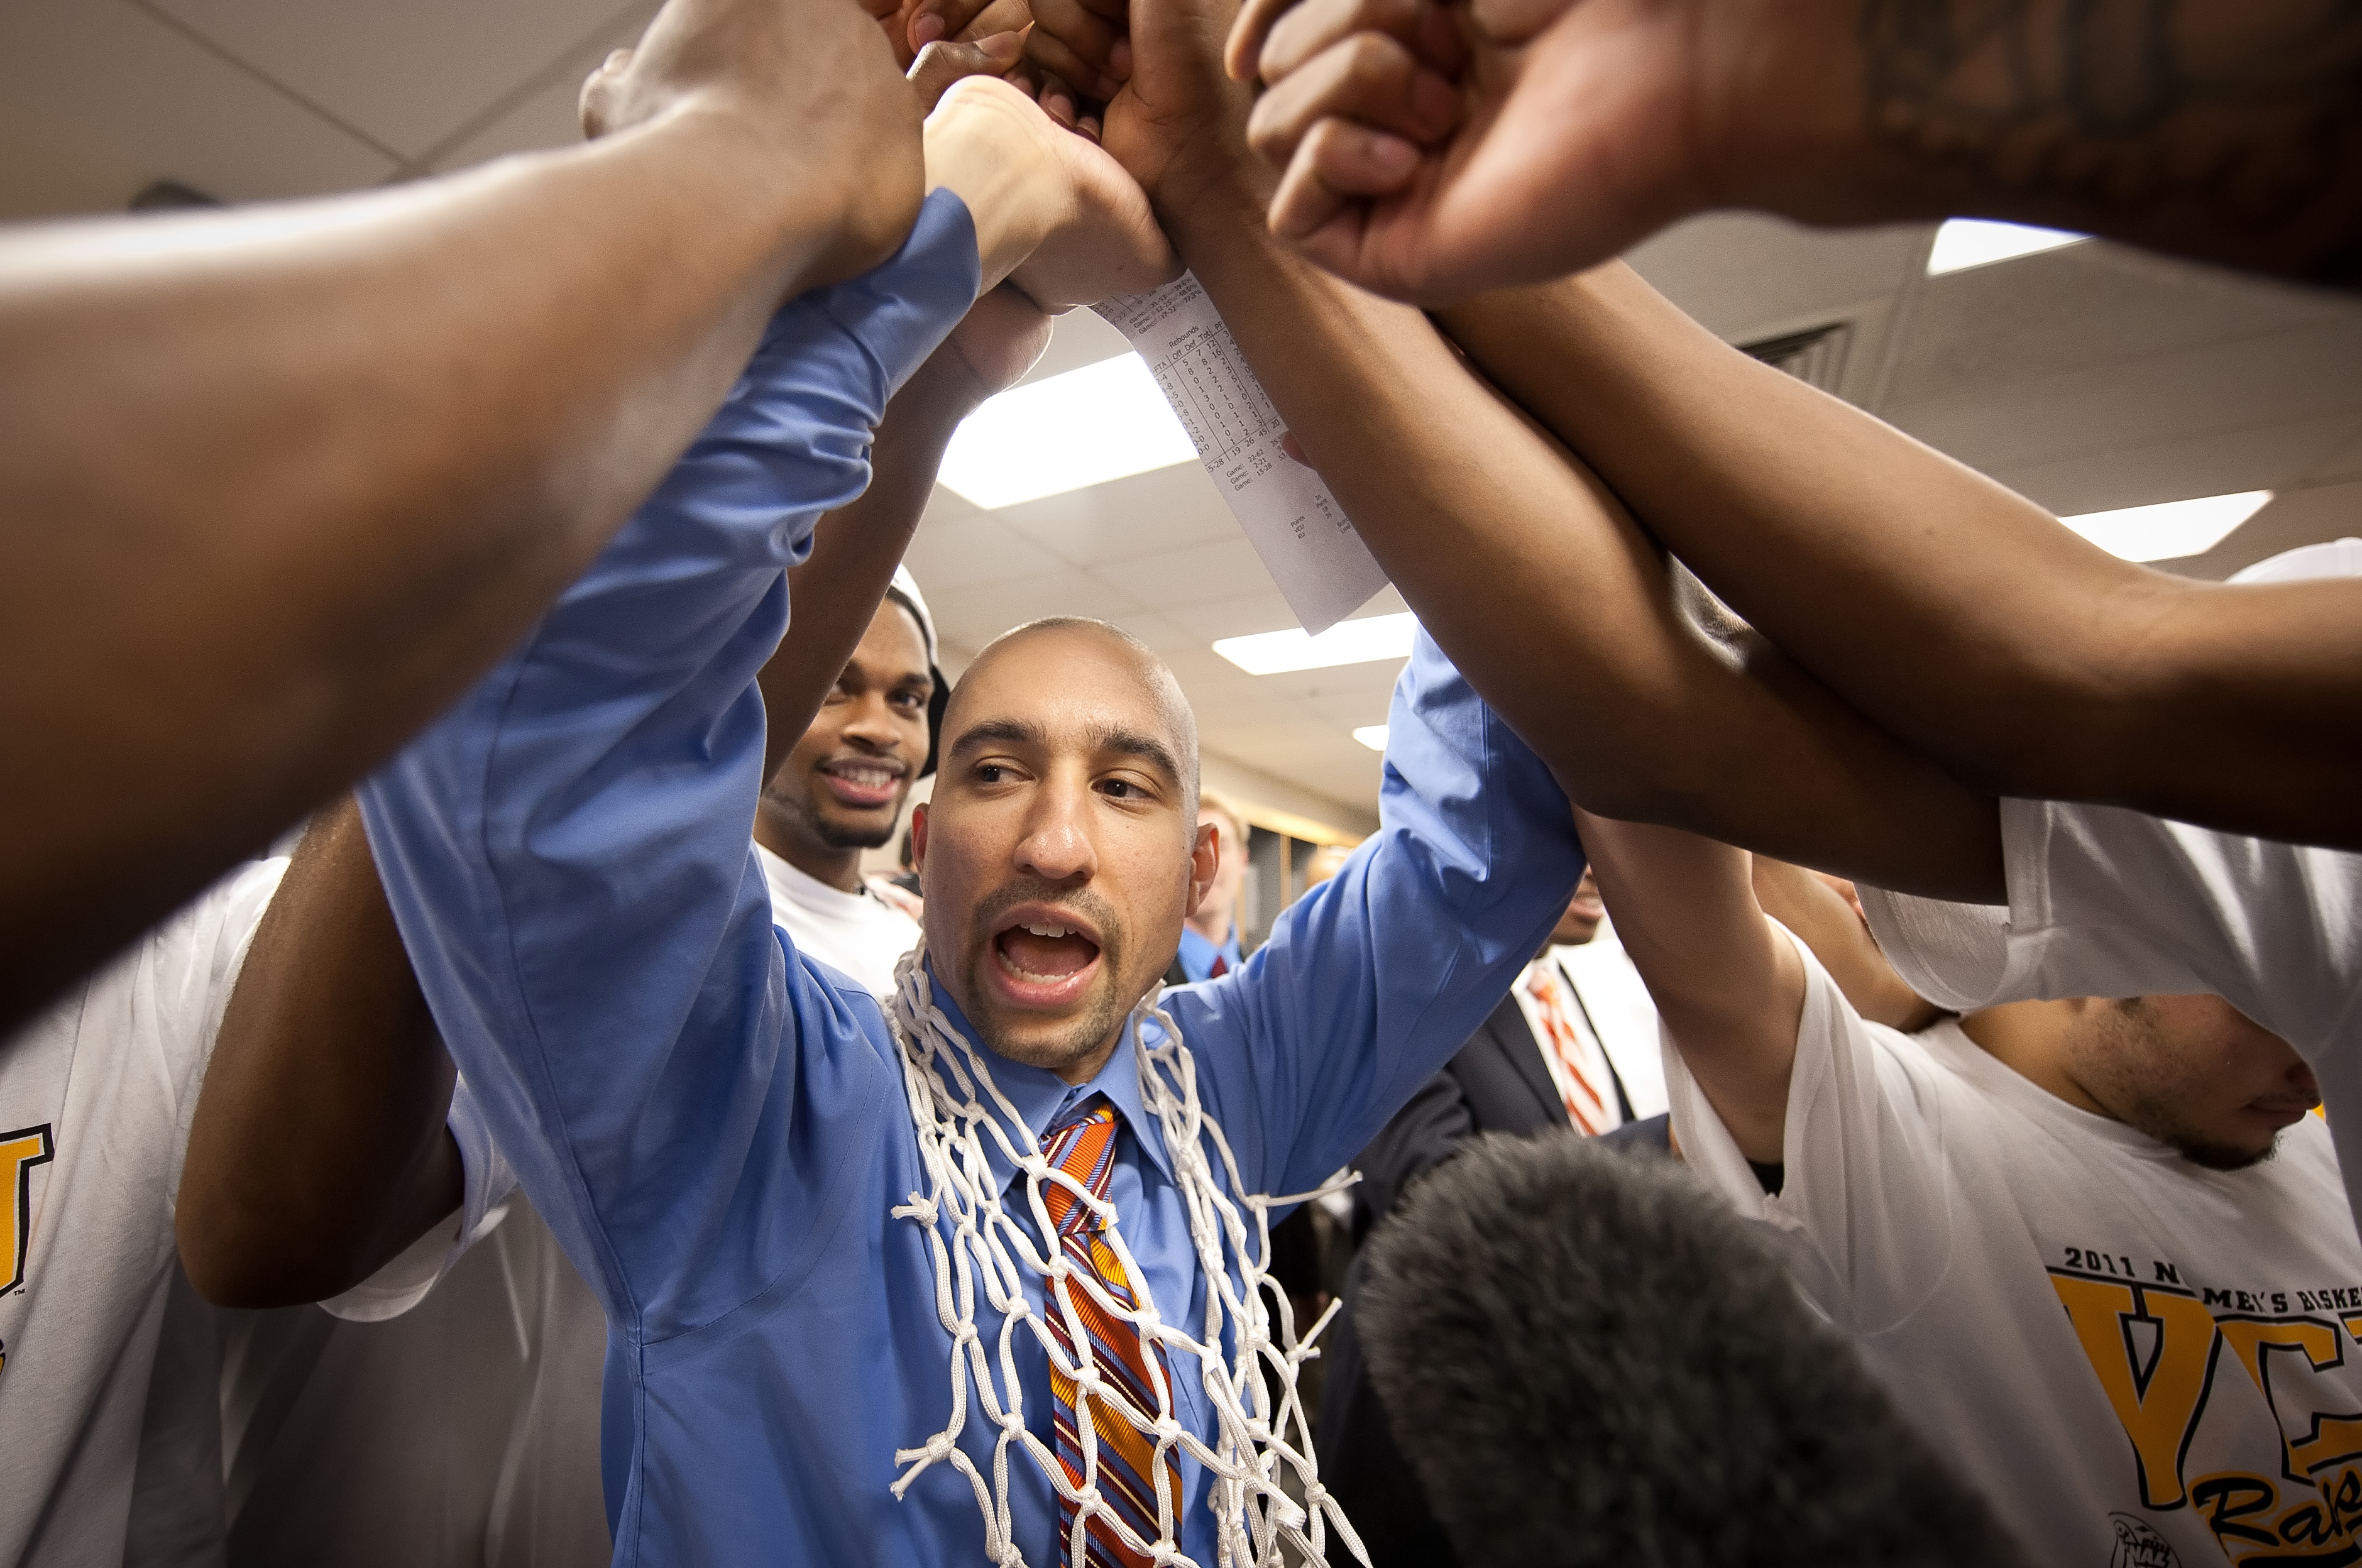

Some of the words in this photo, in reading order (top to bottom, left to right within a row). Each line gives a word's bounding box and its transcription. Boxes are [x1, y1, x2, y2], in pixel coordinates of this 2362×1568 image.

[1169, 326, 1199, 348] Rebounds
[1172, 349, 1182, 359] Off
[1184, 339, 1196, 351] Def
[1199, 331, 1211, 340] Tot
[1182, 358, 1189, 366] 5
[1196, 349, 1201, 357] 7
[1207, 339, 1216, 349] 12
[1212, 348, 1222, 358] 16
[1221, 357, 1227, 365] 2
[1226, 366, 1232, 374] 3
[1204, 394, 1210, 402] 3
[1246, 402, 1253, 410] 2
[1232, 447, 1241, 456] 19
[1244, 437, 1255, 447] 26
[1259, 428, 1267, 436] 45
[1272, 419, 1280, 429] 20
[1226, 464, 1244, 478] Game:
[1248, 449, 1264, 463] 22-62
[1231, 471, 1249, 484] Game:
[1253, 457, 1266, 469] 2-21
[2065, 1247, 2136, 1278] 2011
